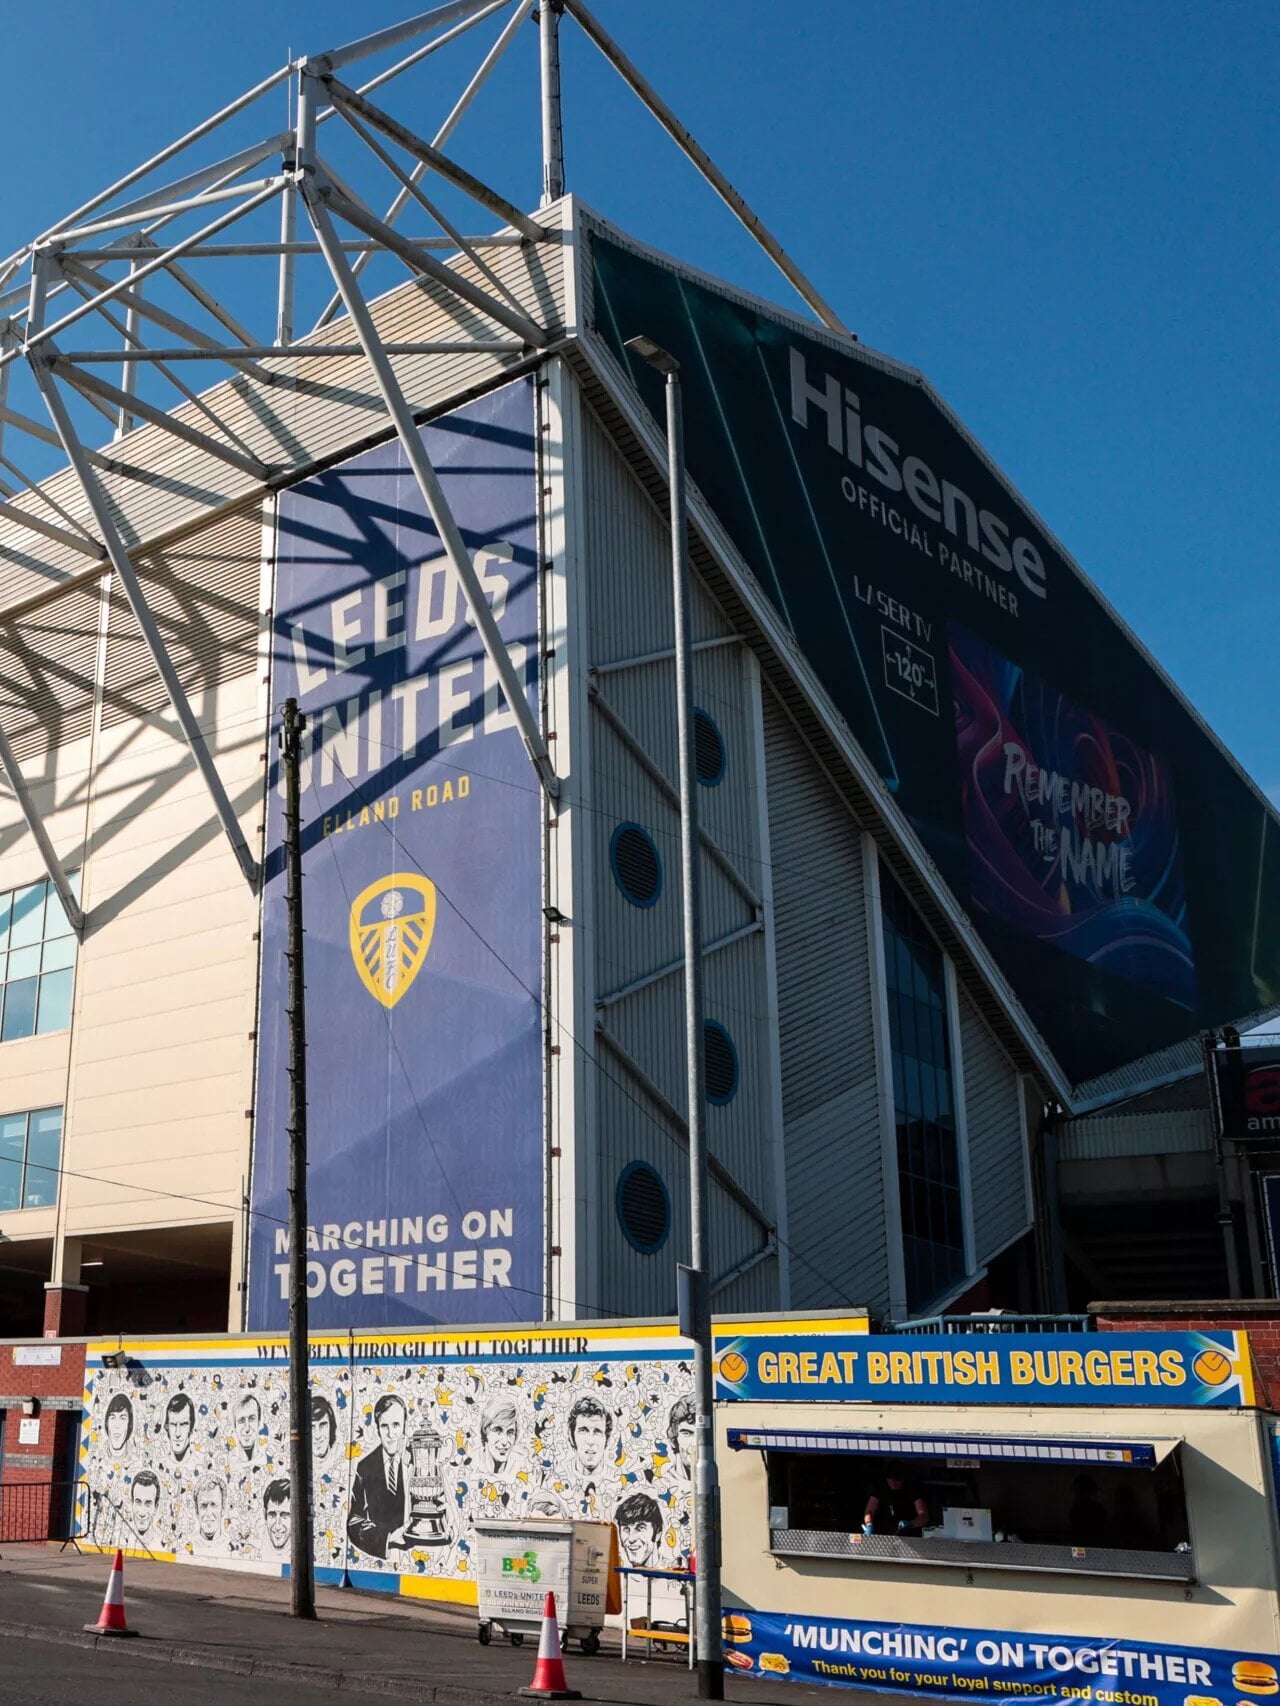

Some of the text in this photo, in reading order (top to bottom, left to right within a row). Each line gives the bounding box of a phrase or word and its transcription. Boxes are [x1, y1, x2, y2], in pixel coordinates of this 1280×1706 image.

[789, 345, 1047, 600] Hisense
[841, 475, 1019, 619] OFFICIAL PARTNER
[290, 540, 514, 697] LEEDS
[323, 775, 470, 836] ELLAND ROAD
[1004, 742, 1132, 838] REMEMBER
[1030, 818, 1058, 853] THE
[1061, 825, 1136, 897] NAME
[461, 1208, 513, 1240] ON
[274, 1248, 512, 1300] TOGETHER
[432, 1340, 449, 1357] IT
[489, 1337, 589, 1356] TOGETHER
[757, 1349, 1187, 1386] GREAT BRITISH BURGERS
[502, 1557, 537, 1573] BWS
[581, 1575, 598, 1585] SUPER
[494, 1590, 519, 1599] LEEDS
[577, 1593, 600, 1606] LEEDS
[812, 1660, 1159, 1706] Thank you for your loyal support and custom
[975, 1640, 1025, 1668] ON
[1028, 1643, 1214, 1687] TOGETHER
